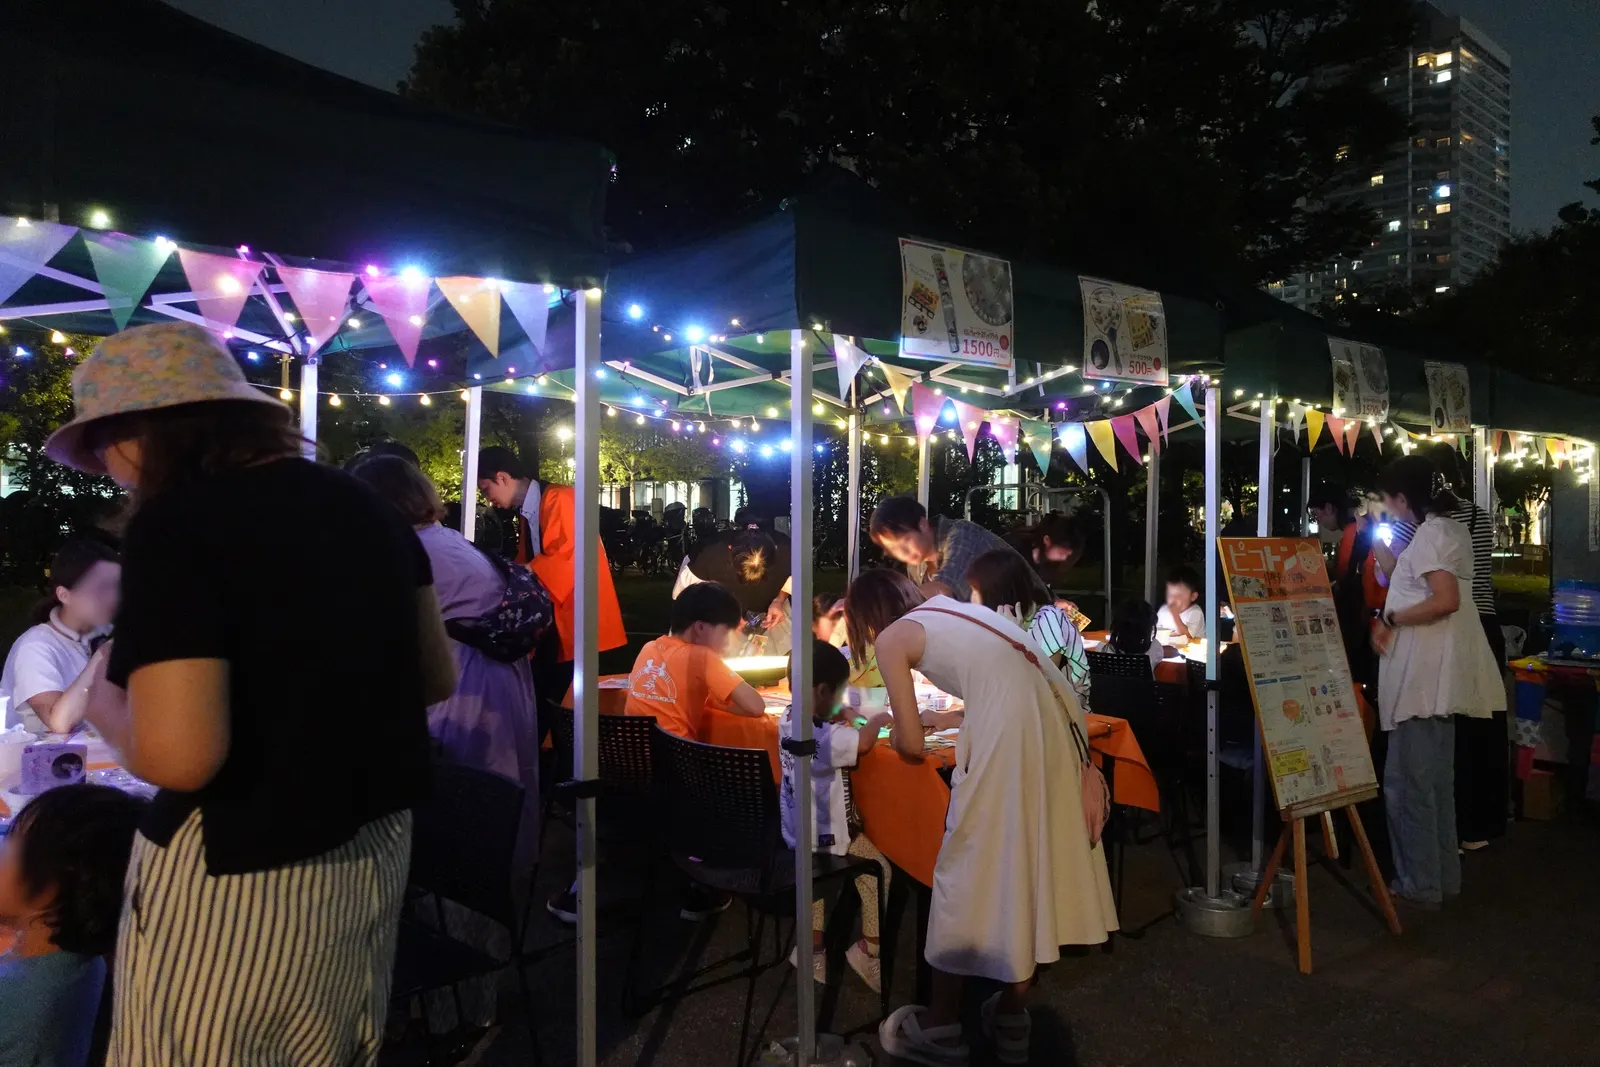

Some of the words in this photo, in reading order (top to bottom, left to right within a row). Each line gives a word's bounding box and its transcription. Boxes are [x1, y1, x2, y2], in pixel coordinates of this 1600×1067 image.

[963, 338, 1000, 357] 1500円
[1228, 540, 1298, 573] ピコトン
